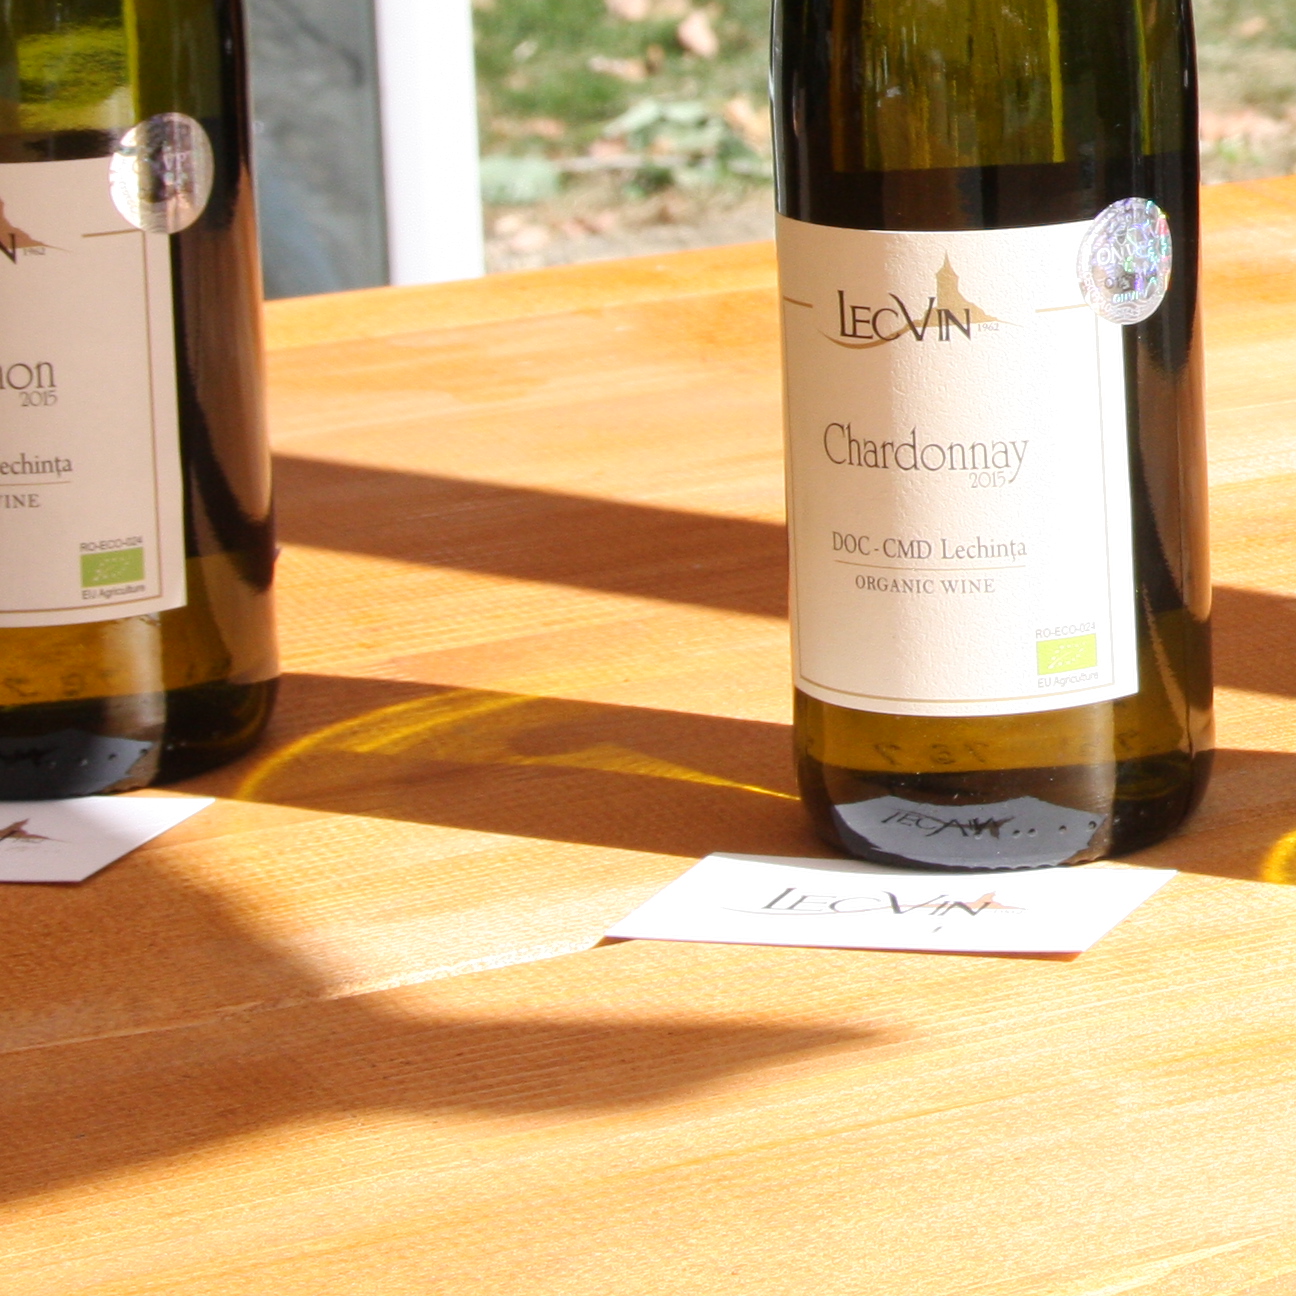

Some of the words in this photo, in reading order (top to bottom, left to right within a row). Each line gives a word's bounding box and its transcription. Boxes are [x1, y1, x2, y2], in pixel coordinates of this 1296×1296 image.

[20, 390, 57, 407] 2015
[823, 421, 1030, 484] Chardonnay
[969, 470, 1006, 489] 2015
[0, 493, 40, 509] INE
[82, 588, 96, 600] EU
[99, 584, 146, 599] Agriculture
[855, 574, 934, 595] ORGANIC
[941, 578, 996, 595] WINE
[1037, 677, 1051, 689] EU
[1053, 671, 1099, 688] Agriculture
